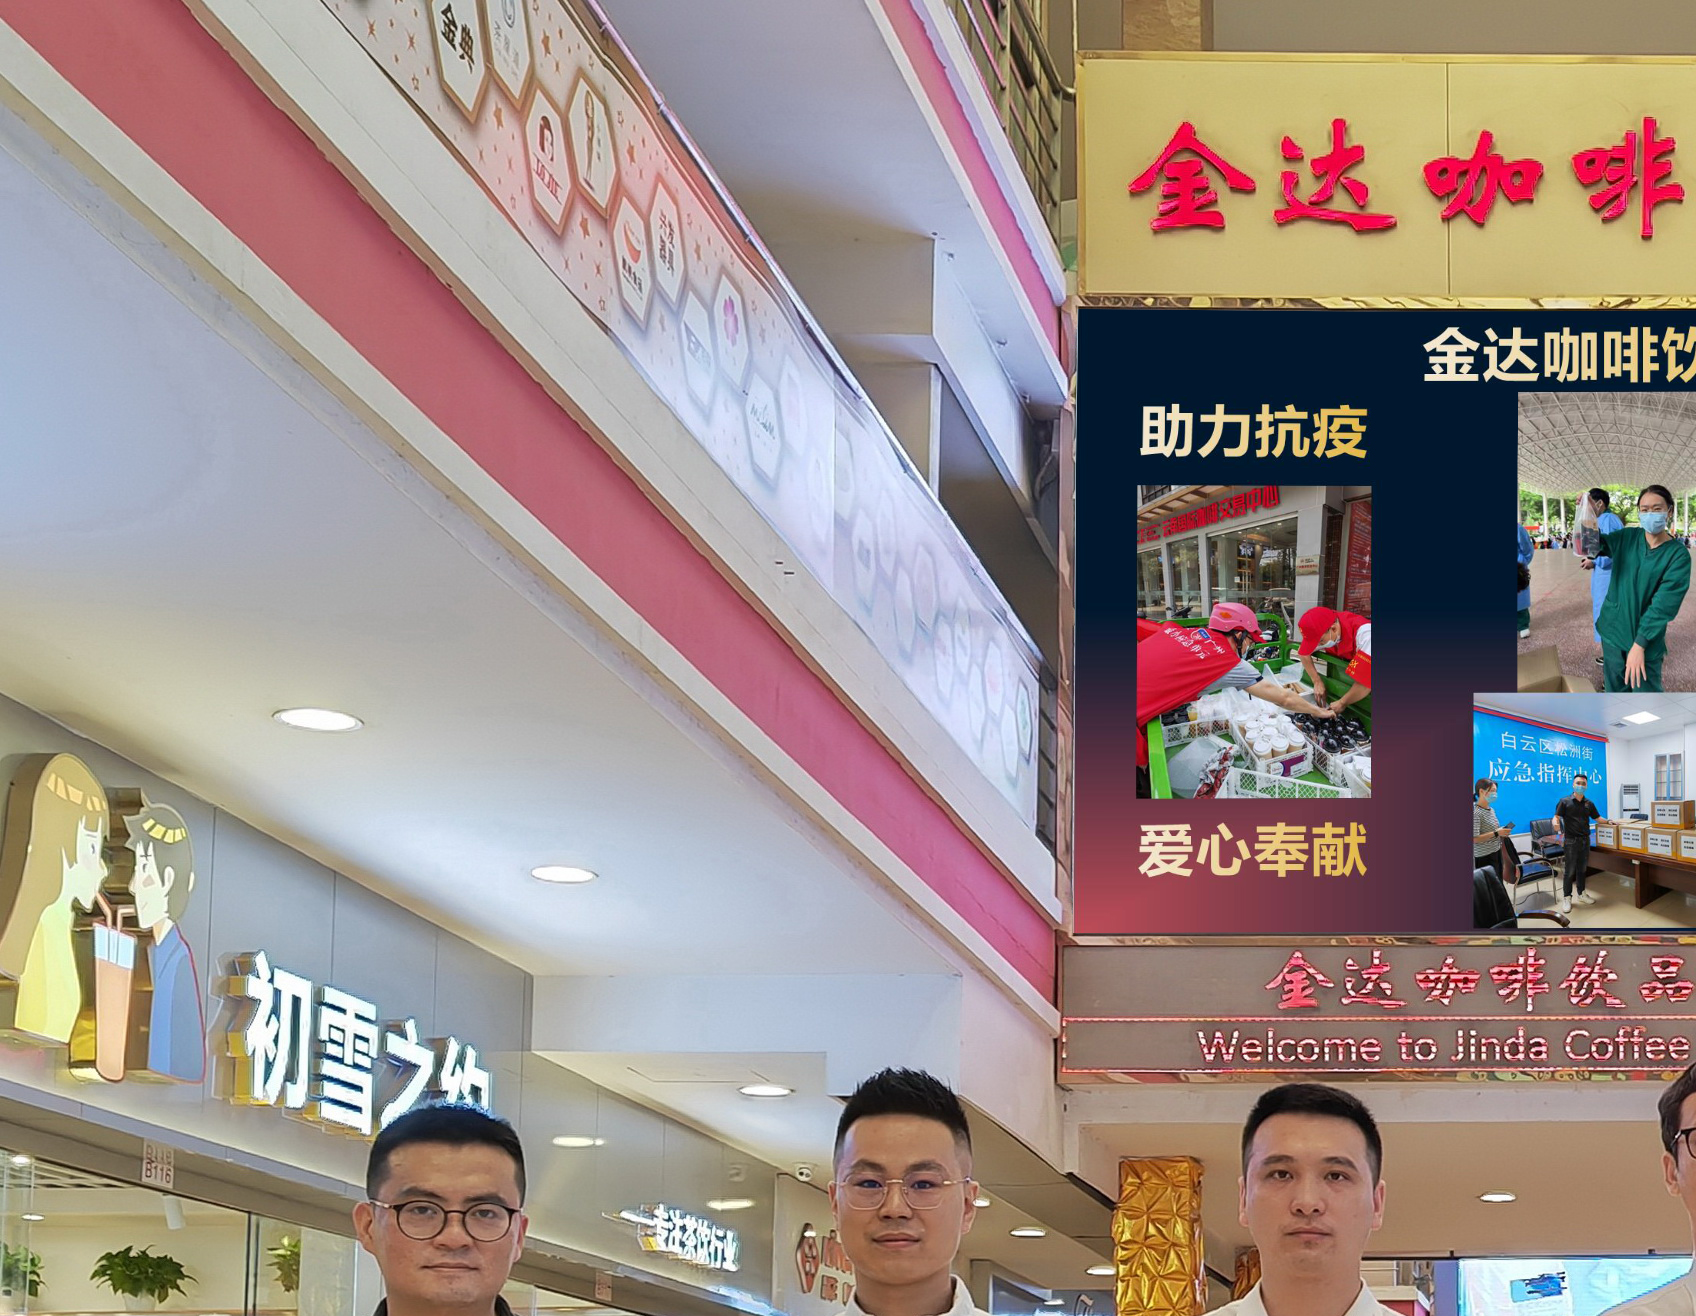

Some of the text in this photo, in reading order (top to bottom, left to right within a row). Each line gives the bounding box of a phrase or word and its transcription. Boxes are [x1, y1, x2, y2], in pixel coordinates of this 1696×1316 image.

[1139, 403, 1369, 460] 助力抗疫
[1501, 731, 1594, 761] 白云区松洲街
[1488, 757, 1603, 785] 应急指挥中心
[1138, 822, 1368, 878] 爱心奉献
[1198, 1029, 1382, 1062] Welcome
[1398, 1031, 1438, 1062] to
[1451, 1027, 1549, 1062] Jinda
[1565, 1027, 1690, 1061] Coffee
[145, 1160, 172, 1183] B116
